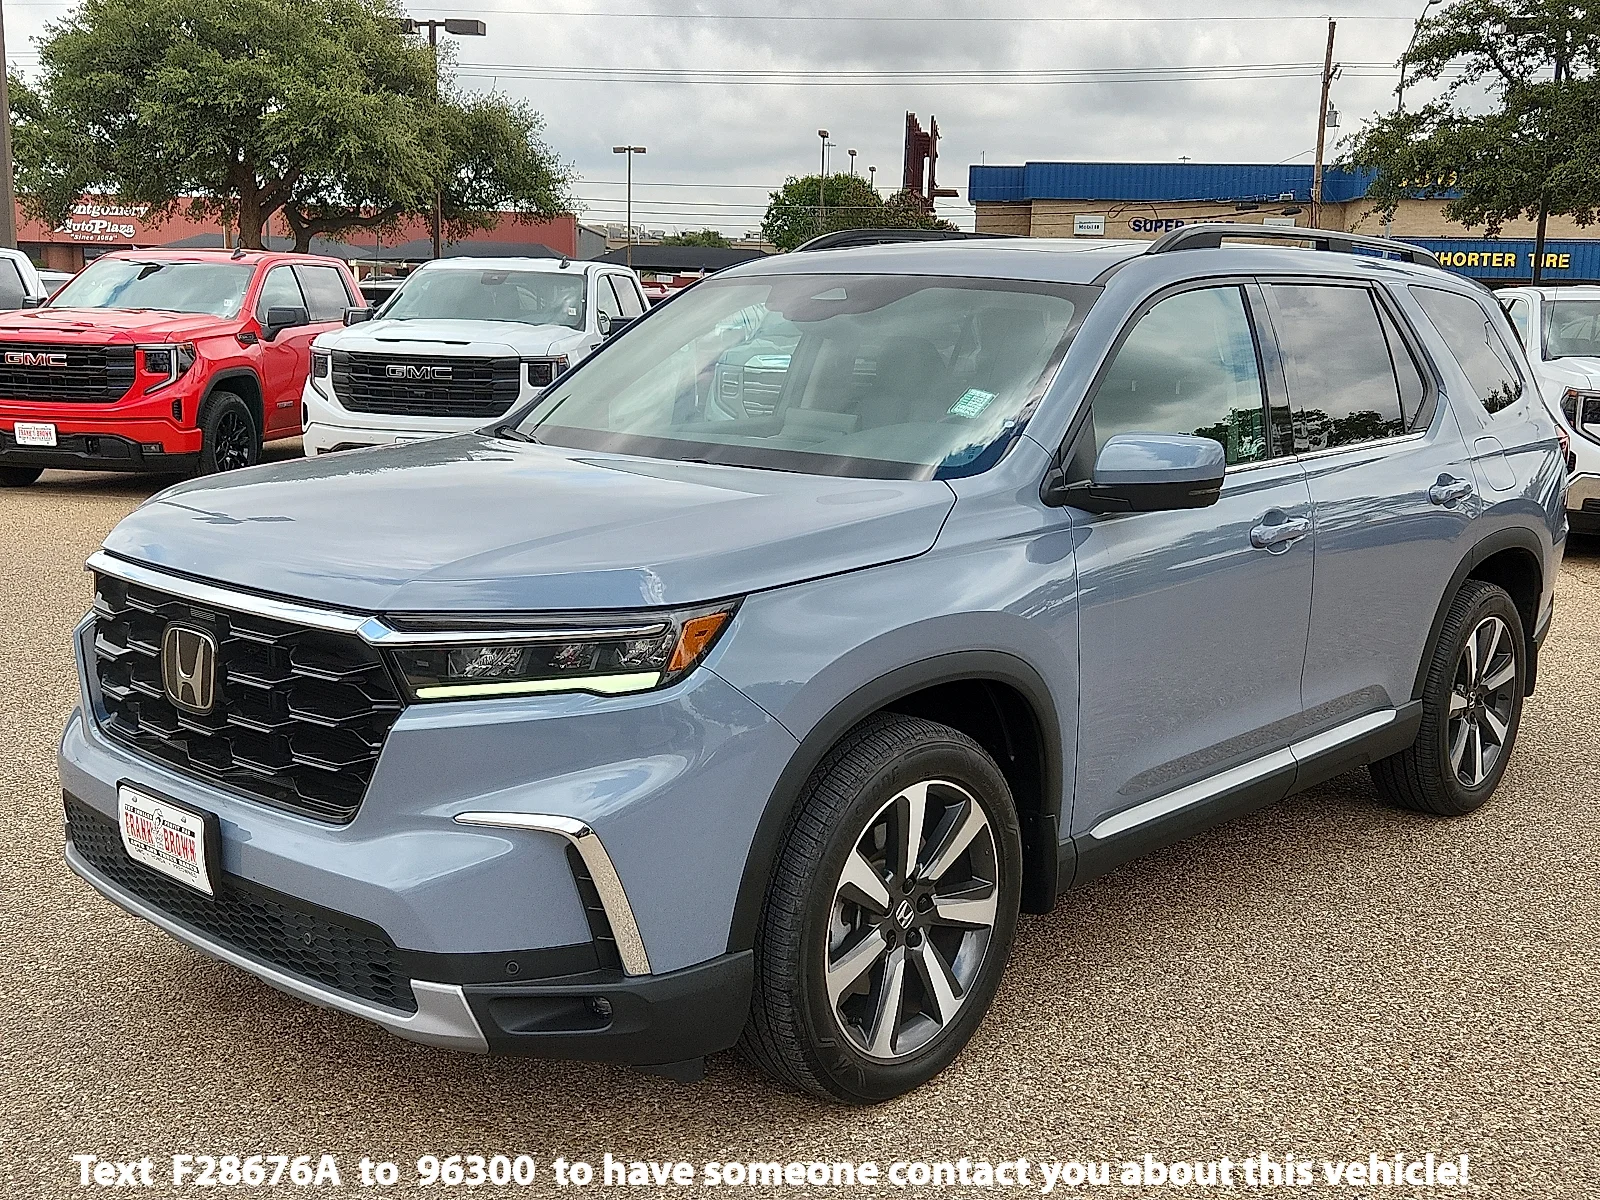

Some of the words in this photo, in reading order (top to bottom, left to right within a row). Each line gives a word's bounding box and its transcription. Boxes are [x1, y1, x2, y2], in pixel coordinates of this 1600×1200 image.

[1528, 253, 1571, 268] TIRE
[5, 352, 67, 367] GMC
[386, 365, 453, 380] GMC
[125, 812, 154, 844] FRANK
[163, 828, 197, 864] BROWN
